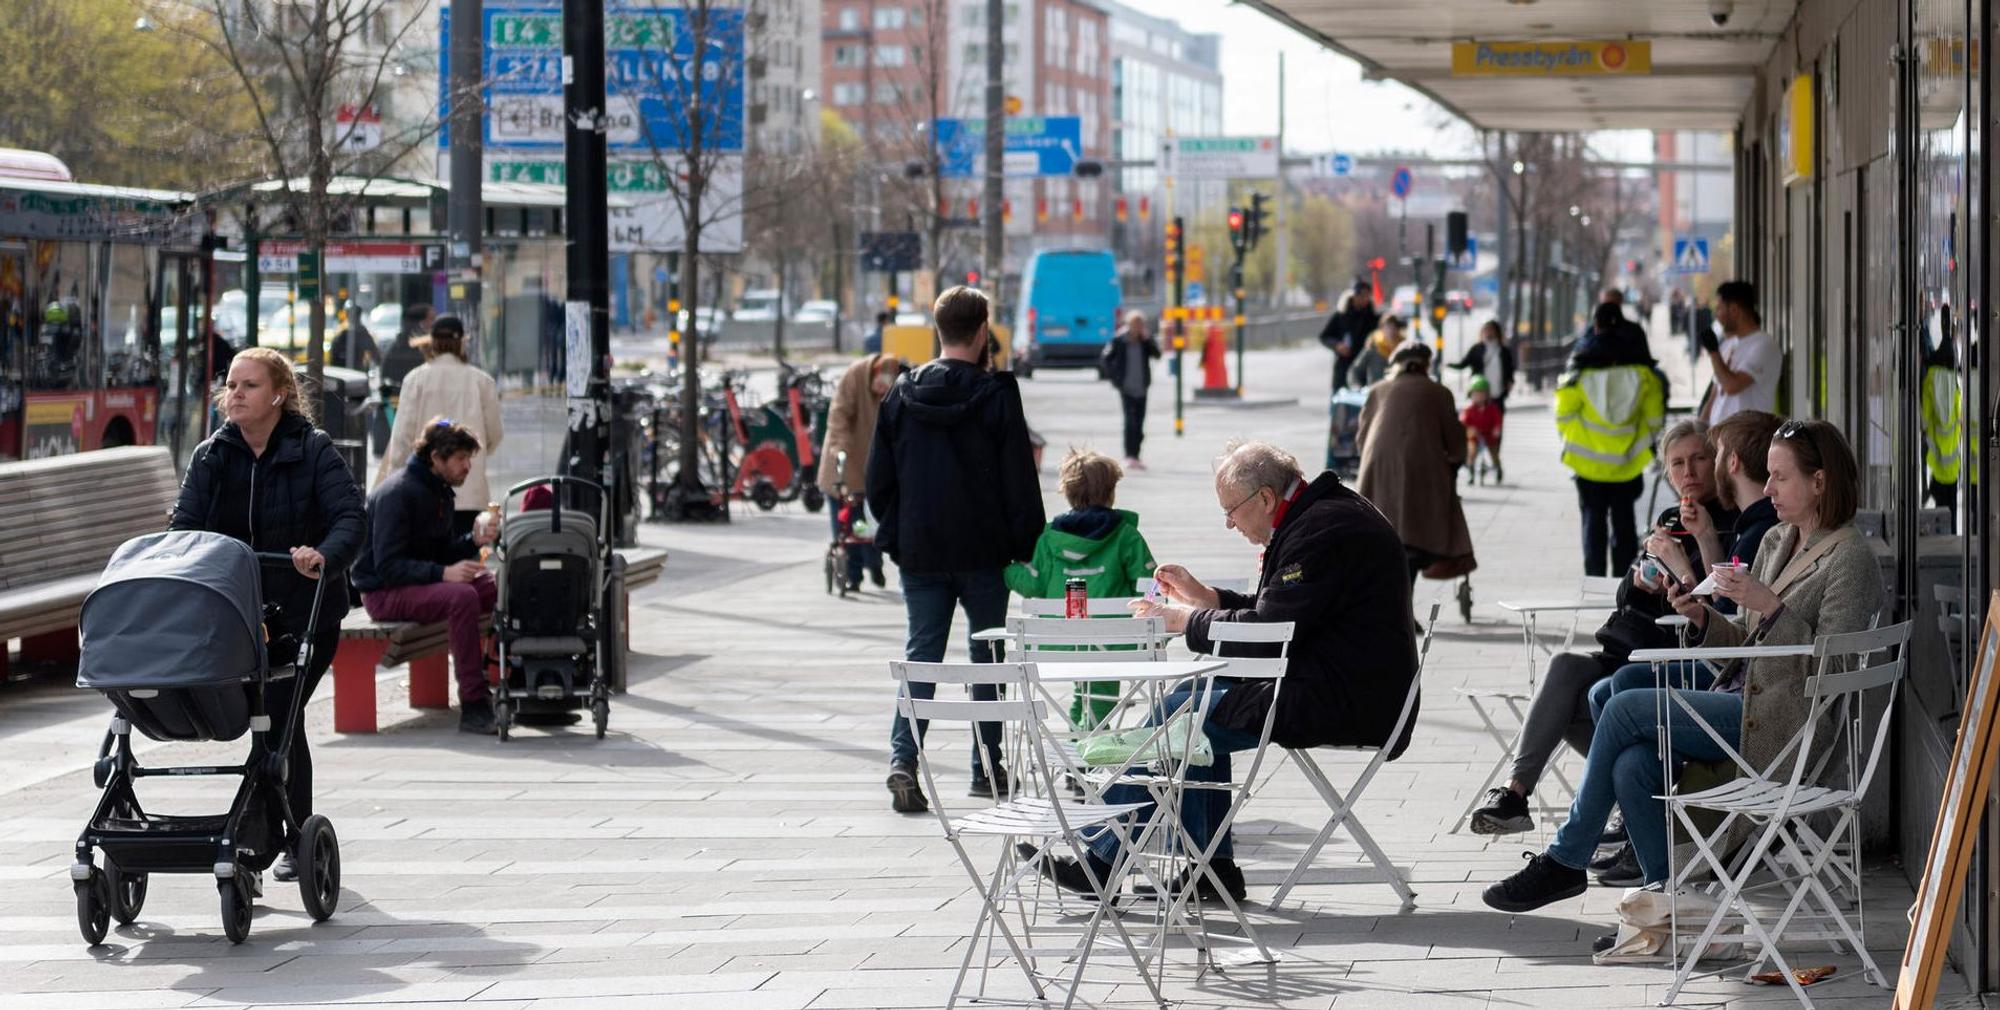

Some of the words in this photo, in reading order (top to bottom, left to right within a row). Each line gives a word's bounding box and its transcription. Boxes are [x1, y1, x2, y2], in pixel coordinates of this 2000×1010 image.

[604, 54, 736, 82] ÄLLINGBY
[1474, 43, 1592, 70] Pressbyrån
[426, 246, 441, 269] F
